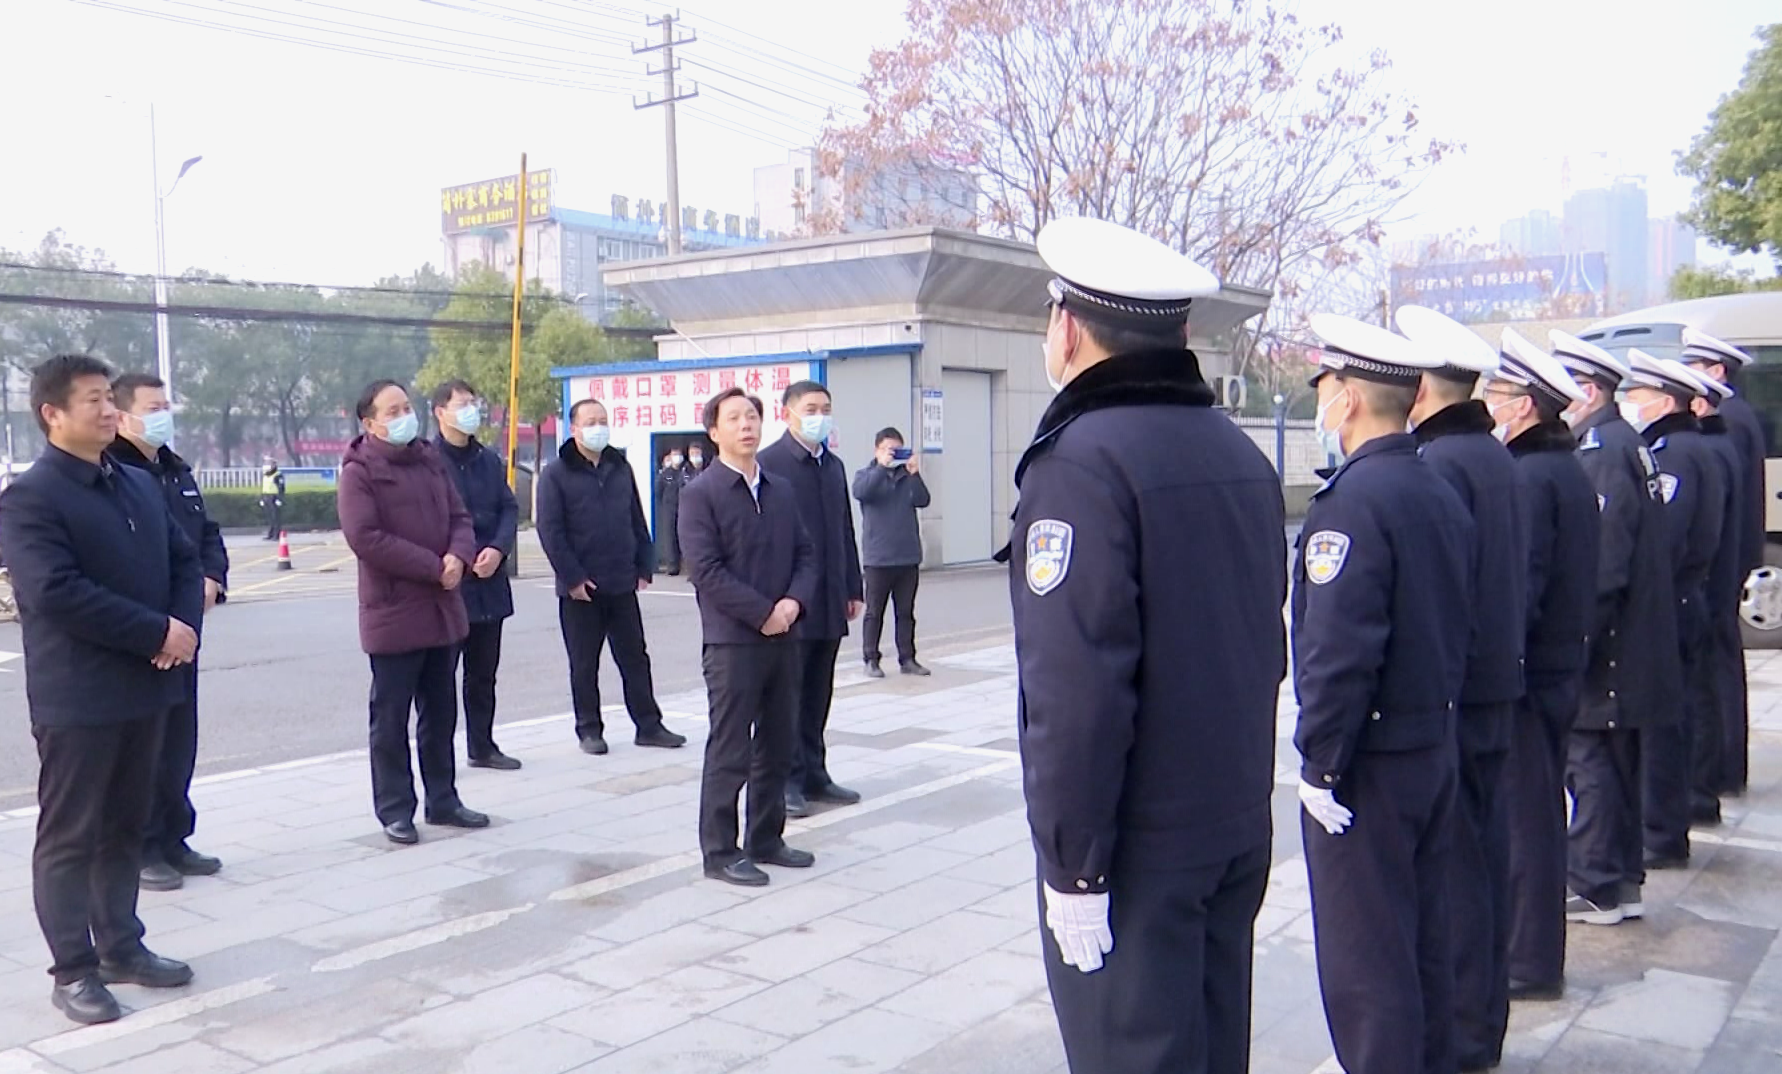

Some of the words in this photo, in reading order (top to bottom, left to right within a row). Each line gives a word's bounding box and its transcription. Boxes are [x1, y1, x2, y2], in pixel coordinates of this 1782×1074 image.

[589, 374, 677, 400] 佩戴口罩
[693, 366, 791, 395] 测量体温
[613, 404, 677, 427] 序扫码
